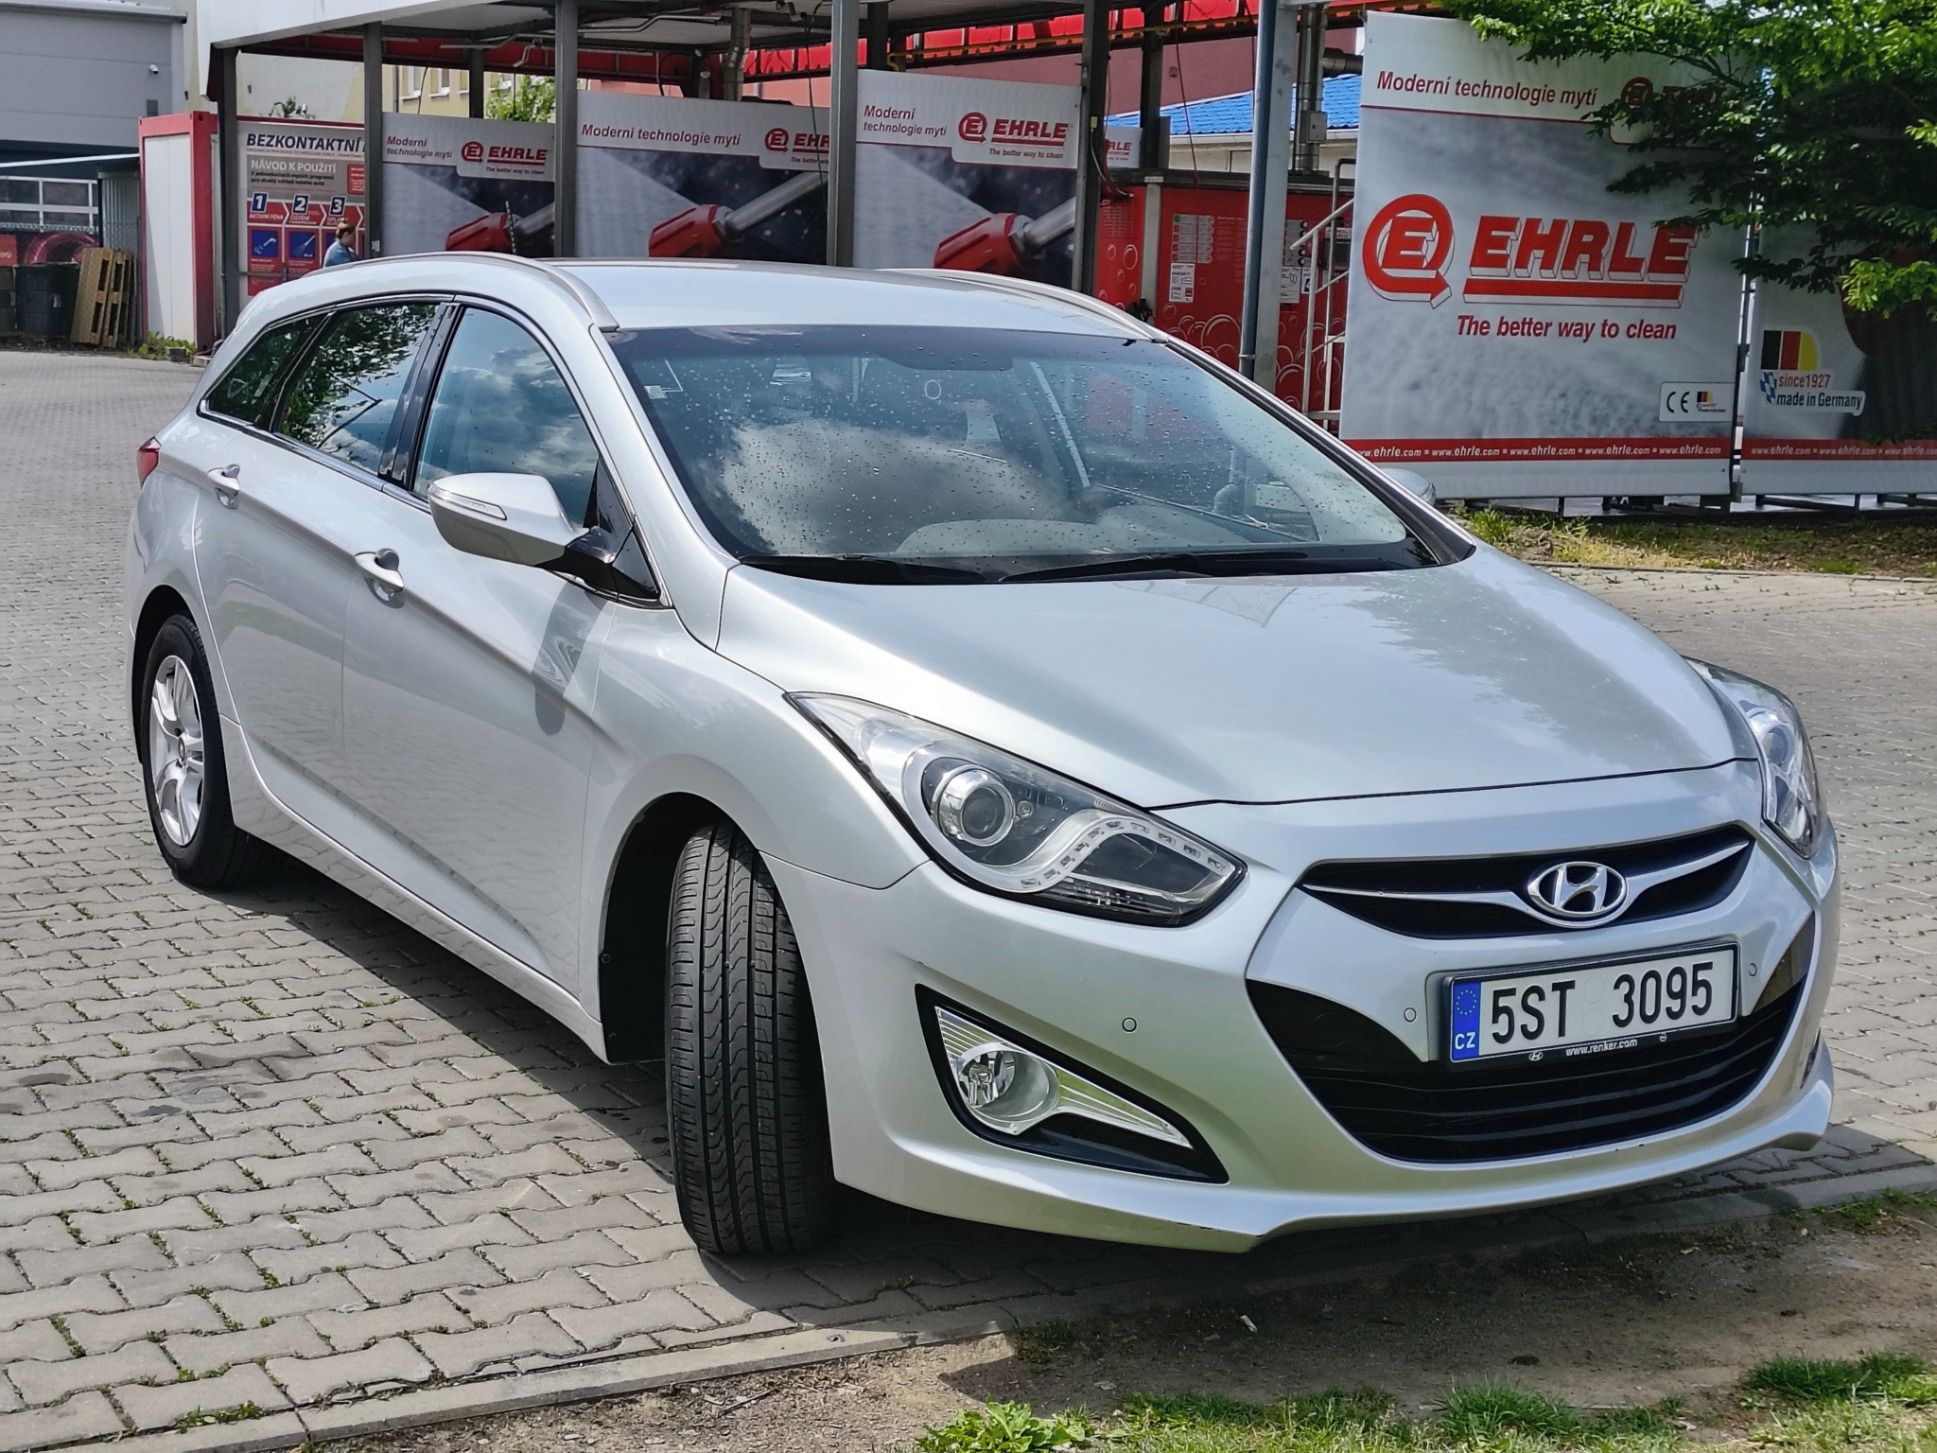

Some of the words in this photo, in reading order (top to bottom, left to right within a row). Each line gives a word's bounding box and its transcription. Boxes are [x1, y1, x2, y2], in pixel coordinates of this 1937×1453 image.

[1377, 70, 1451, 95] Moderní
[1455, 79, 1556, 107] technologie
[1560, 88, 1599, 110] mytí
[638, 128, 711, 145] technologie
[864, 122, 922, 136] technologie
[993, 118, 1069, 139] EHRLE
[246, 133, 362, 152] BEZKONTAKTNÍ
[487, 146, 548, 161] EHRLE
[250, 159, 287, 171] NÁVOD
[289, 162, 296, 171] K
[255, 195, 264, 210] 1
[295, 197, 306, 212] 2
[332, 199, 343, 213] 3
[1469, 215, 1698, 283] EHRLE
[1457, 315, 1491, 336] The
[1496, 316, 1552, 337] better
[1558, 321, 1596, 343] way
[1601, 319, 1620, 338] to
[1626, 320, 1678, 340] clean
[1778, 372, 1831, 388] since1927
[1776, 392, 1805, 406] made
[1806, 392, 1816, 406] in
[1818, 391, 1863, 410] Germany
[1431, 445, 1500, 457] www.ehrle.com
[1509, 445, 1576, 456] www.ehrle.com
[1585, 444, 1650, 455] www.ehrle.com
[1659, 444, 1722, 455] www.ehrle.com
[1491, 979, 1576, 1044] 5ST
[1612, 961, 1714, 1028] 3095
[1454, 1031, 1476, 1050] CZ
[1565, 1039, 1638, 1056] www.renker.com
